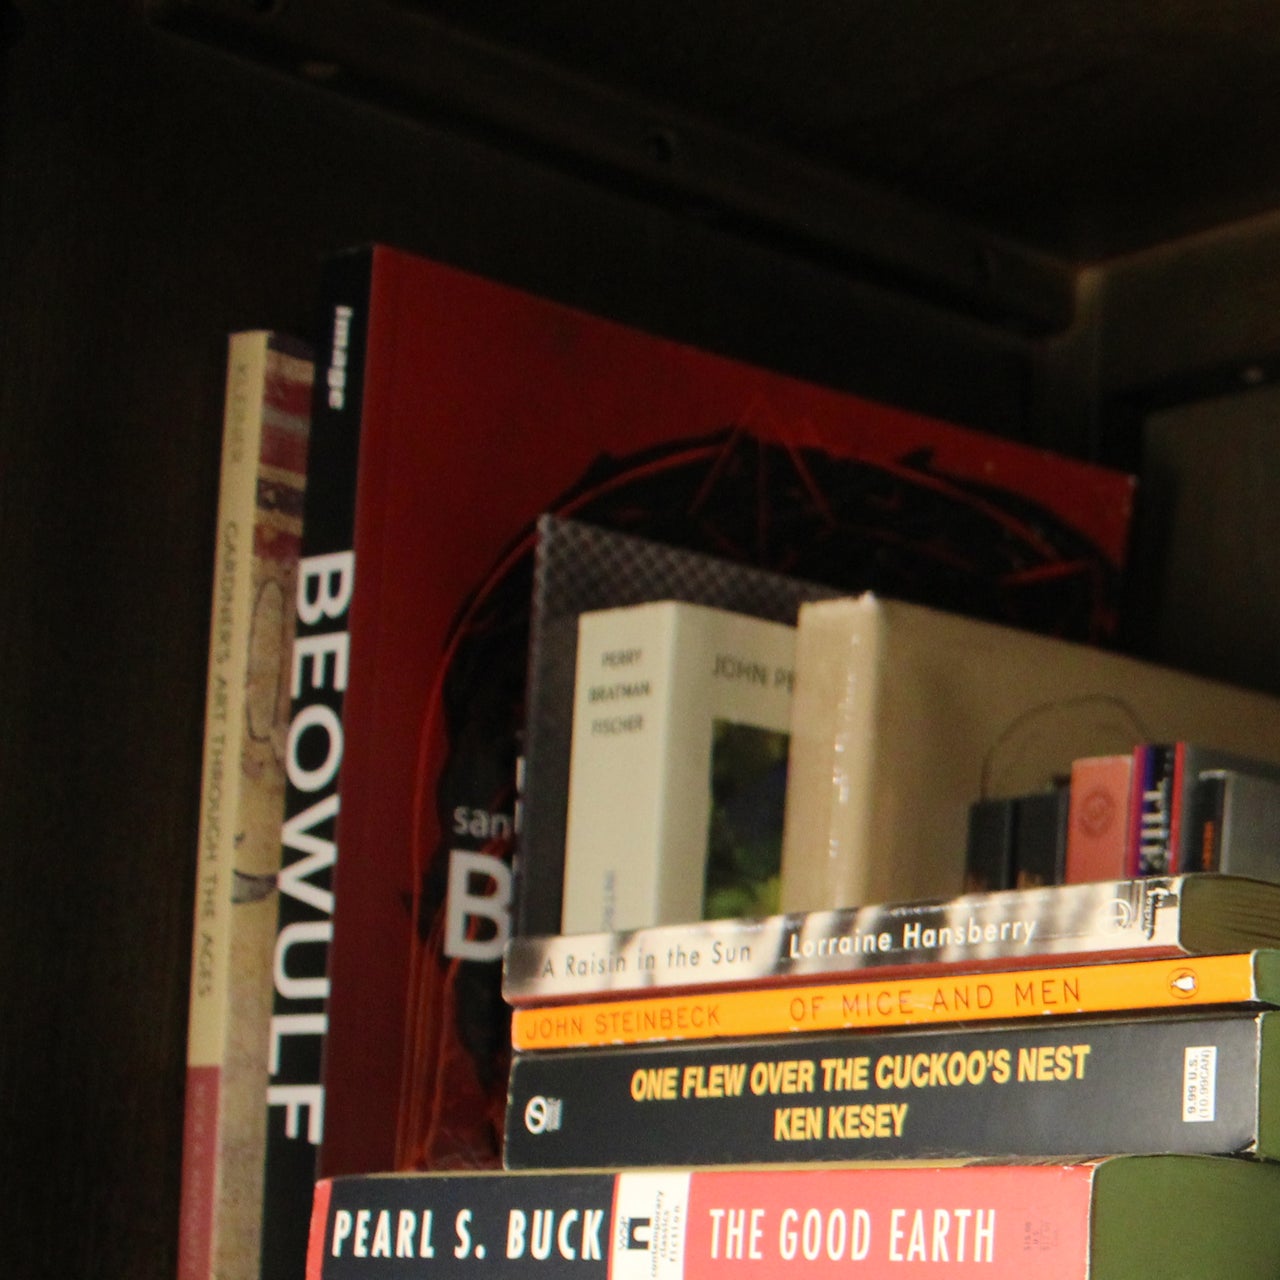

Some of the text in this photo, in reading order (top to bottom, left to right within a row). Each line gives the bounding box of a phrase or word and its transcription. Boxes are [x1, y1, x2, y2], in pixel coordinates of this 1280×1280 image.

[265, 550, 356, 1146] BEOWULF
[543, 914, 1037, 980] A Raisin in the Sun Lorraine Hansberry
[525, 977, 1082, 1040] JOHN STEINBECK OF MICE AND MEN
[631, 1044, 1090, 1101] ONE FLEW OVER THE CUCKOO'S NEST
[1187, 1085, 1198, 1114] 9.99
[774, 1102, 908, 1141] KEN KESEY
[332, 1208, 604, 1262] PEARL S. BUCK
[710, 1208, 763, 1260] THE
[778, 1207, 871, 1262] GOOD
[889, 1207, 996, 1264] EARTH
